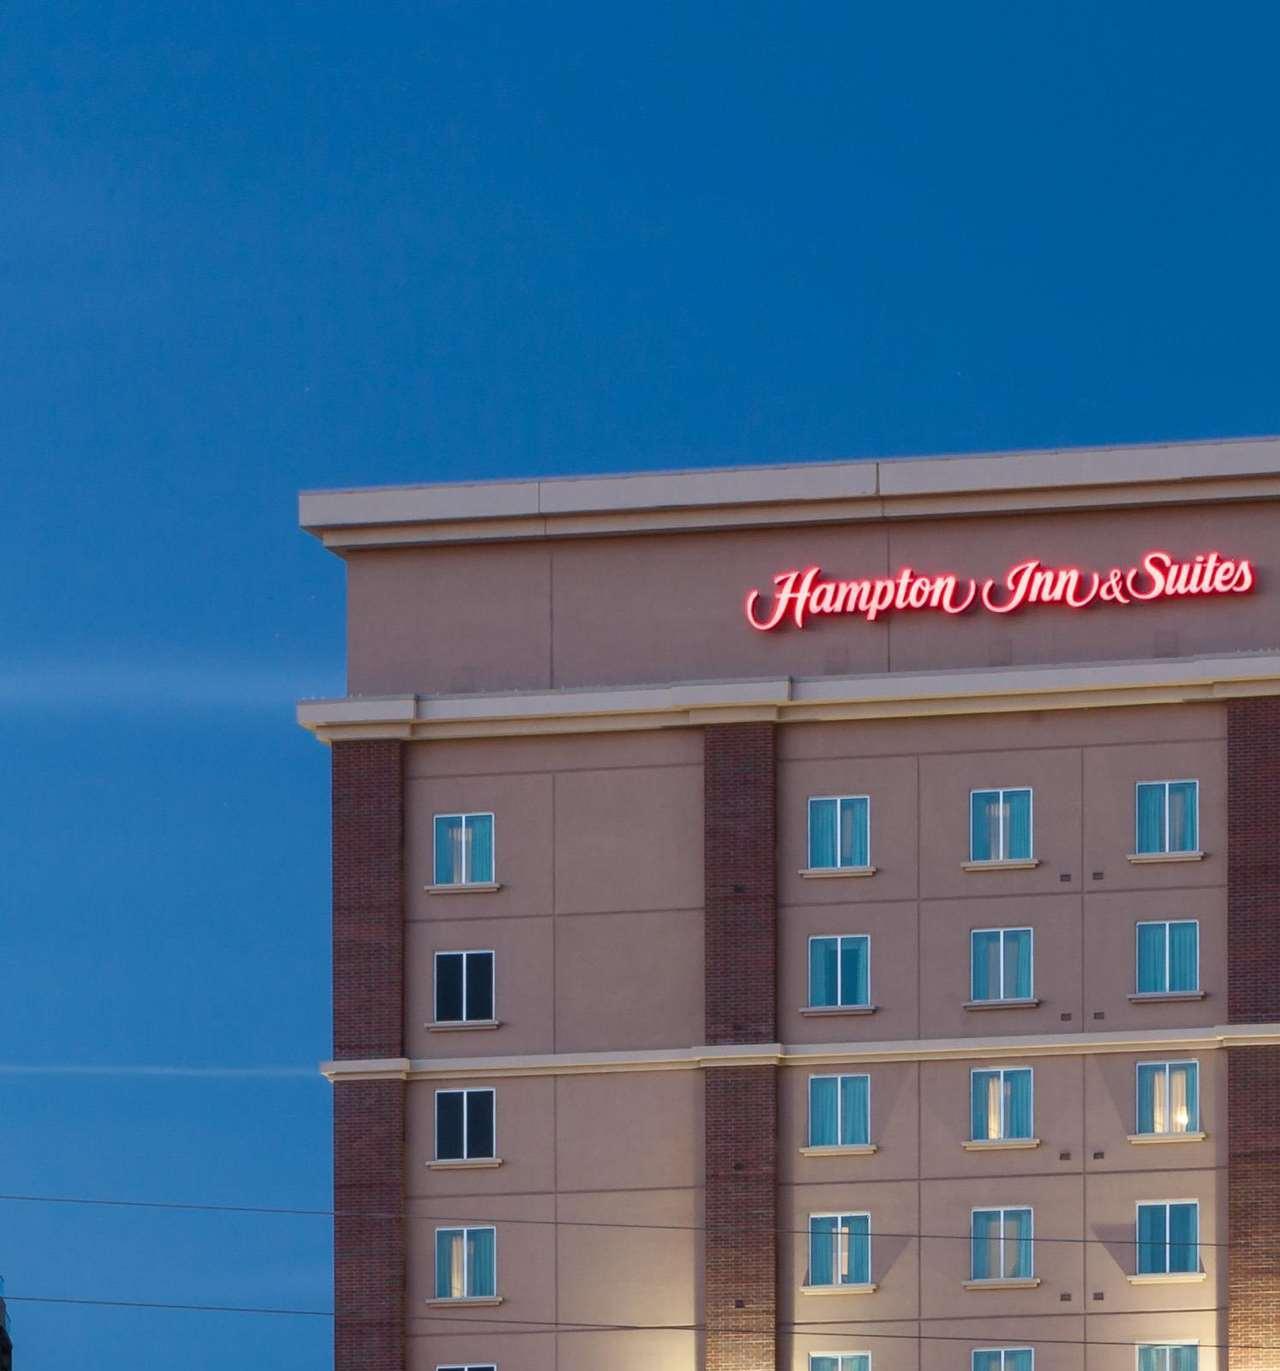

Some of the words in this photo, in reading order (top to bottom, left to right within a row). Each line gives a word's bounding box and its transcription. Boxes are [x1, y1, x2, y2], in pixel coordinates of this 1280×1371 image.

[747, 567, 976, 630] Hampton
[983, 560, 1099, 613] Inn
[1101, 569, 1130, 603] &
[1126, 552, 1254, 601] Suites
